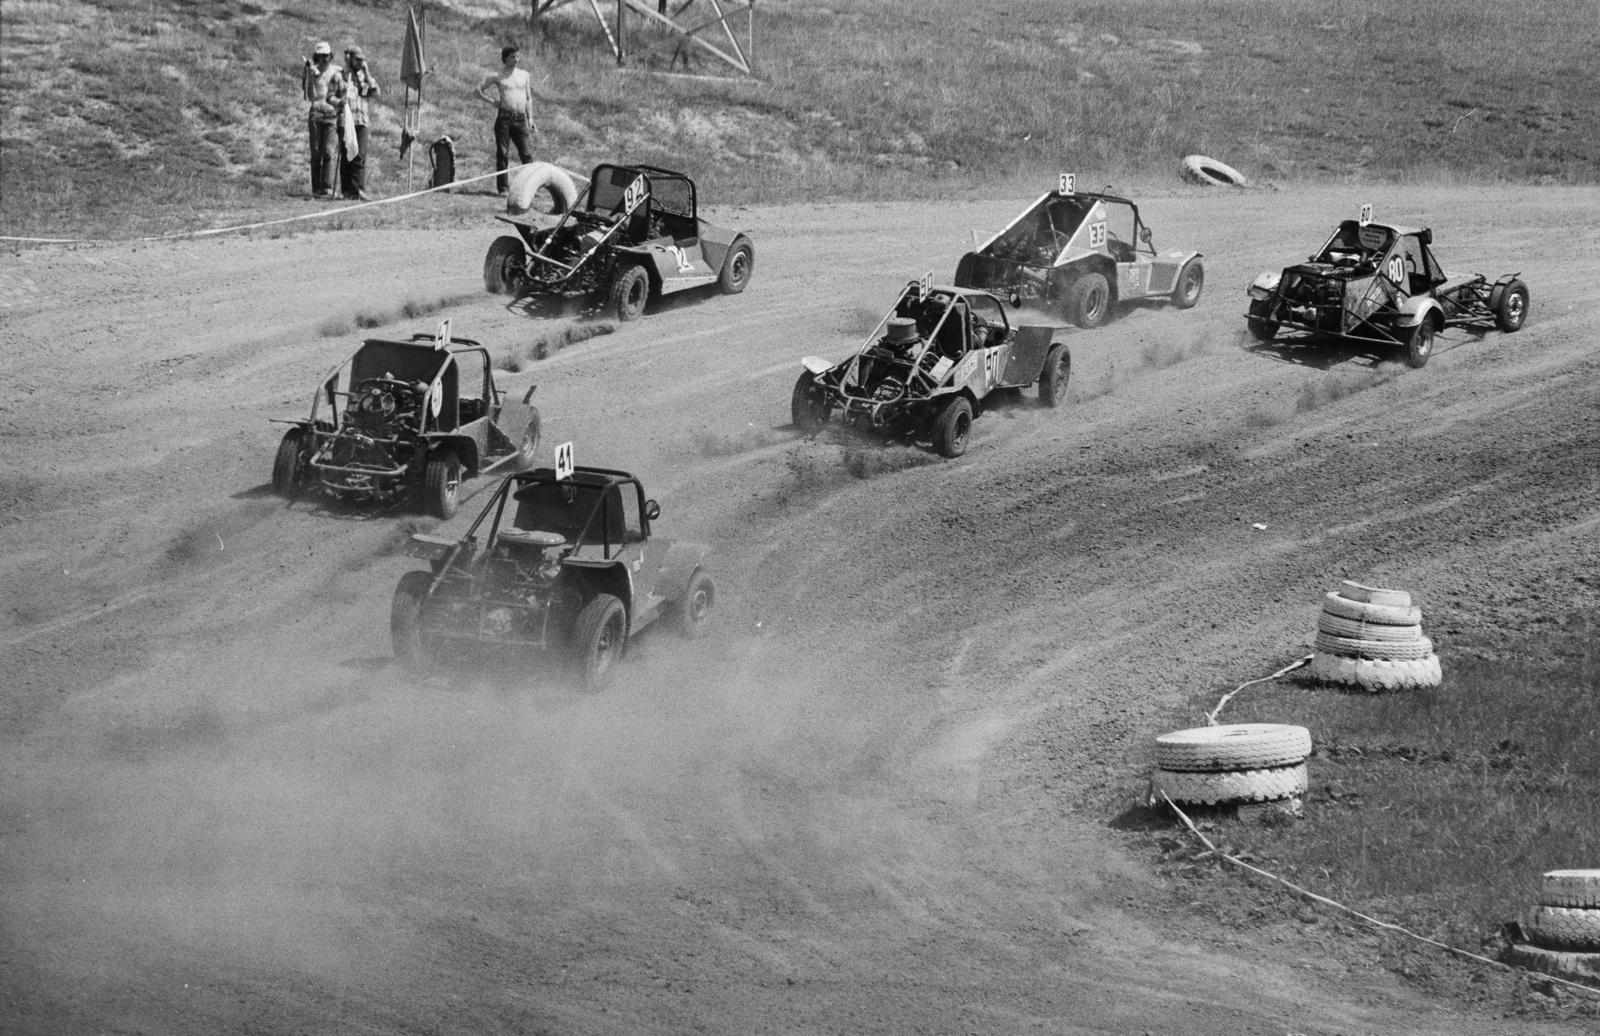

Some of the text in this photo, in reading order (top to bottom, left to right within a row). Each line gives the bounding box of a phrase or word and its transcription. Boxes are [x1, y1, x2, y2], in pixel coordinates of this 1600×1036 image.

[626, 178, 643, 209] 92
[1060, 175, 1074, 193] 33
[1092, 226, 1105, 244] 33
[1388, 257, 1404, 283] 80
[558, 444, 572, 473] 41
